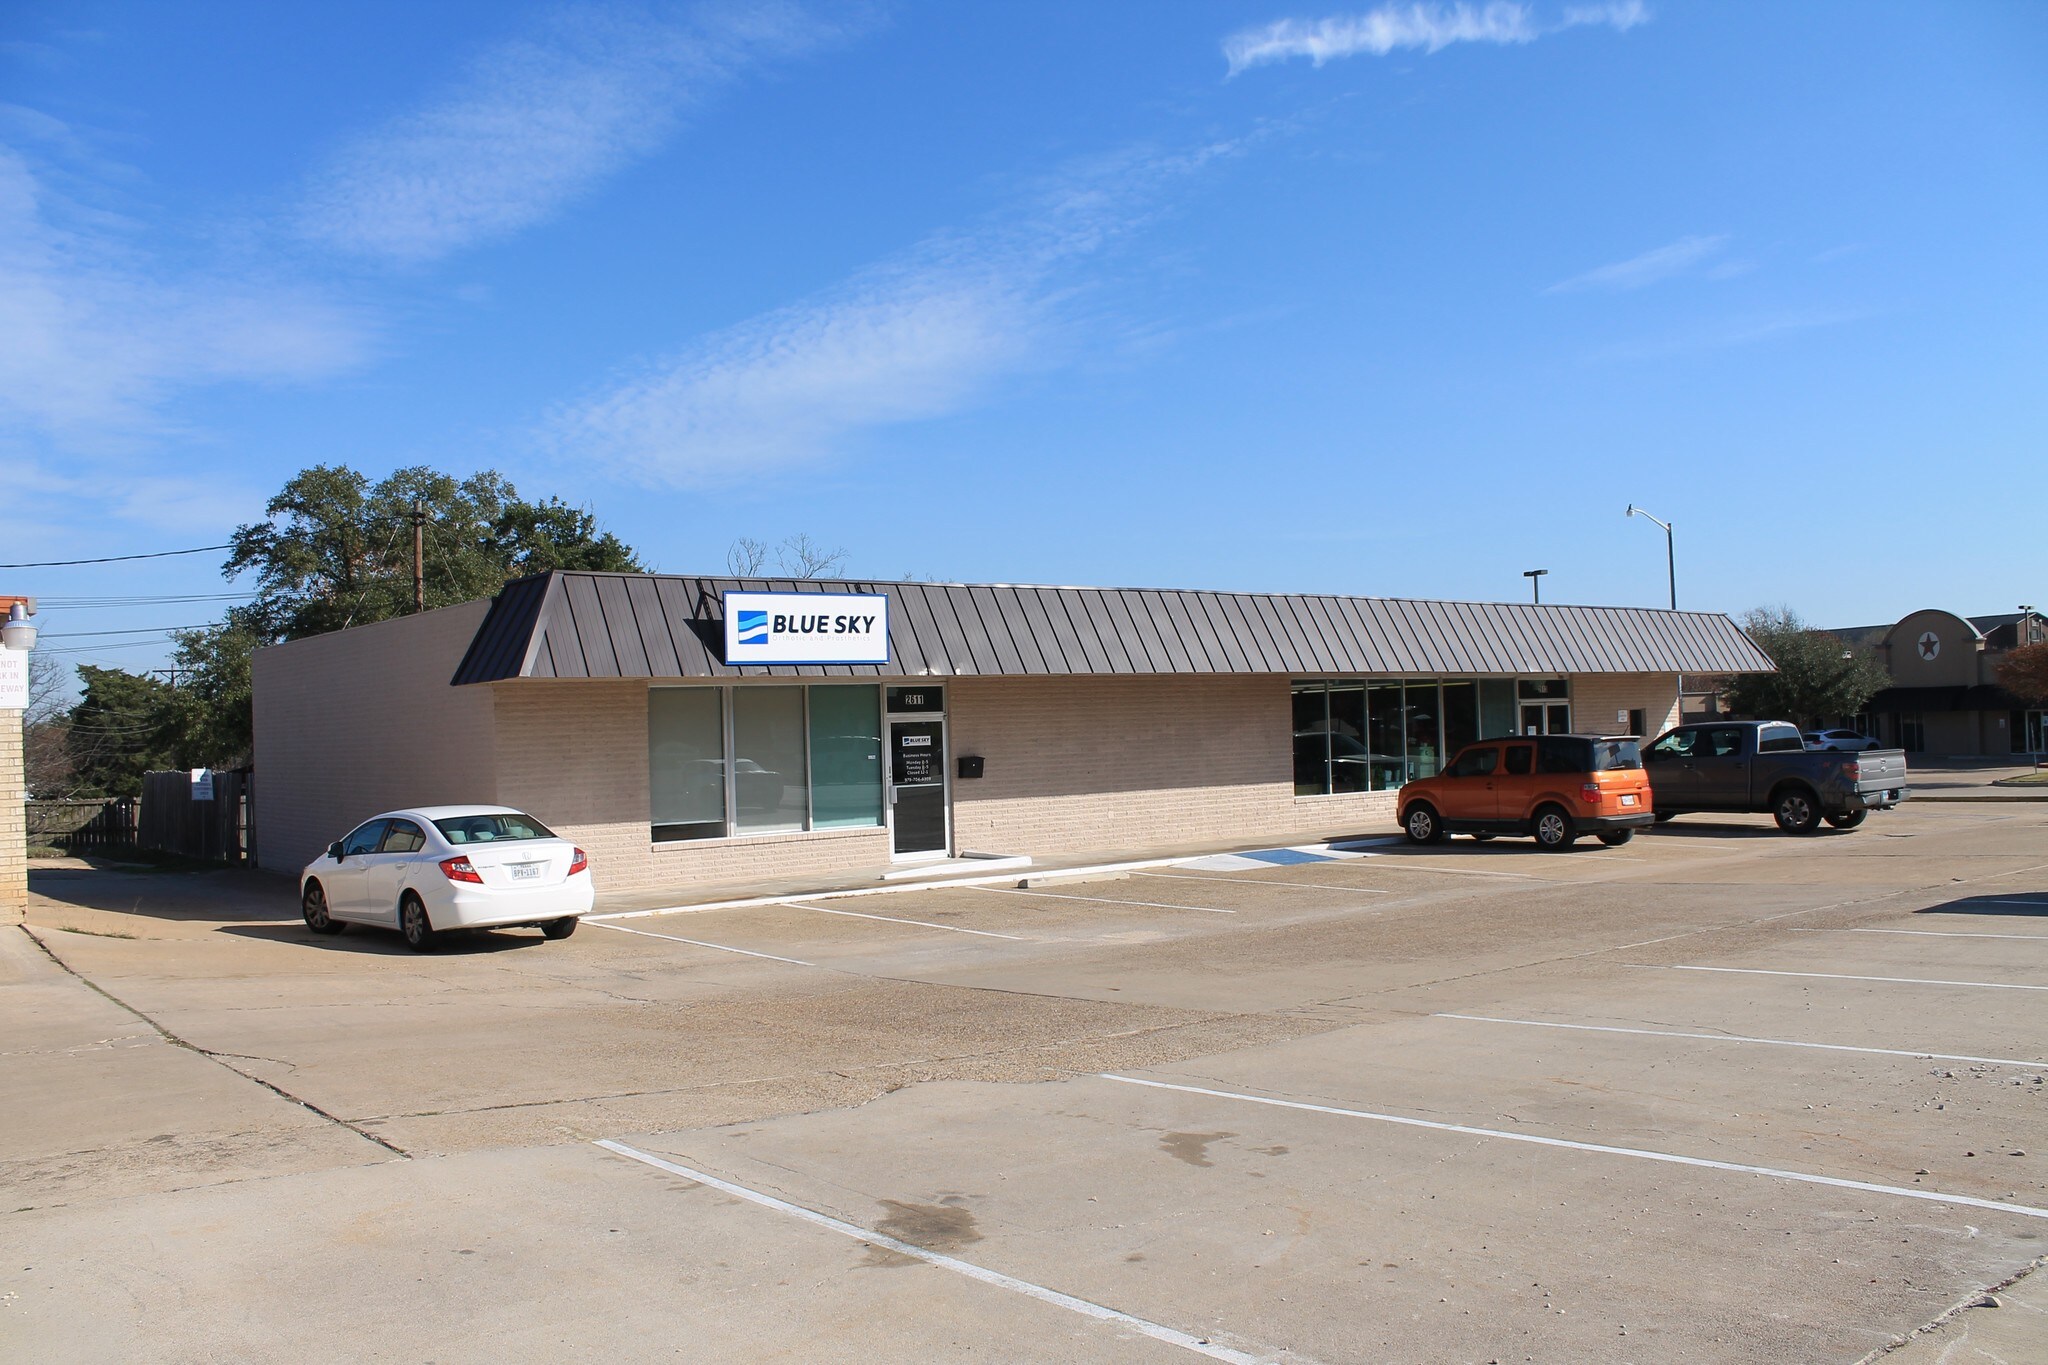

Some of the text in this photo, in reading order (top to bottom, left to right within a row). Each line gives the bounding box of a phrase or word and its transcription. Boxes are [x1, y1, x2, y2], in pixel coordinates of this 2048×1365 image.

[773, 615, 876, 634] BLUE SKY
[827, 634, 871, 642] Prosthetics
[1, 660, 17, 668] NOT
[10, 671, 19, 679] IN
[905, 694, 924, 704] 2611
